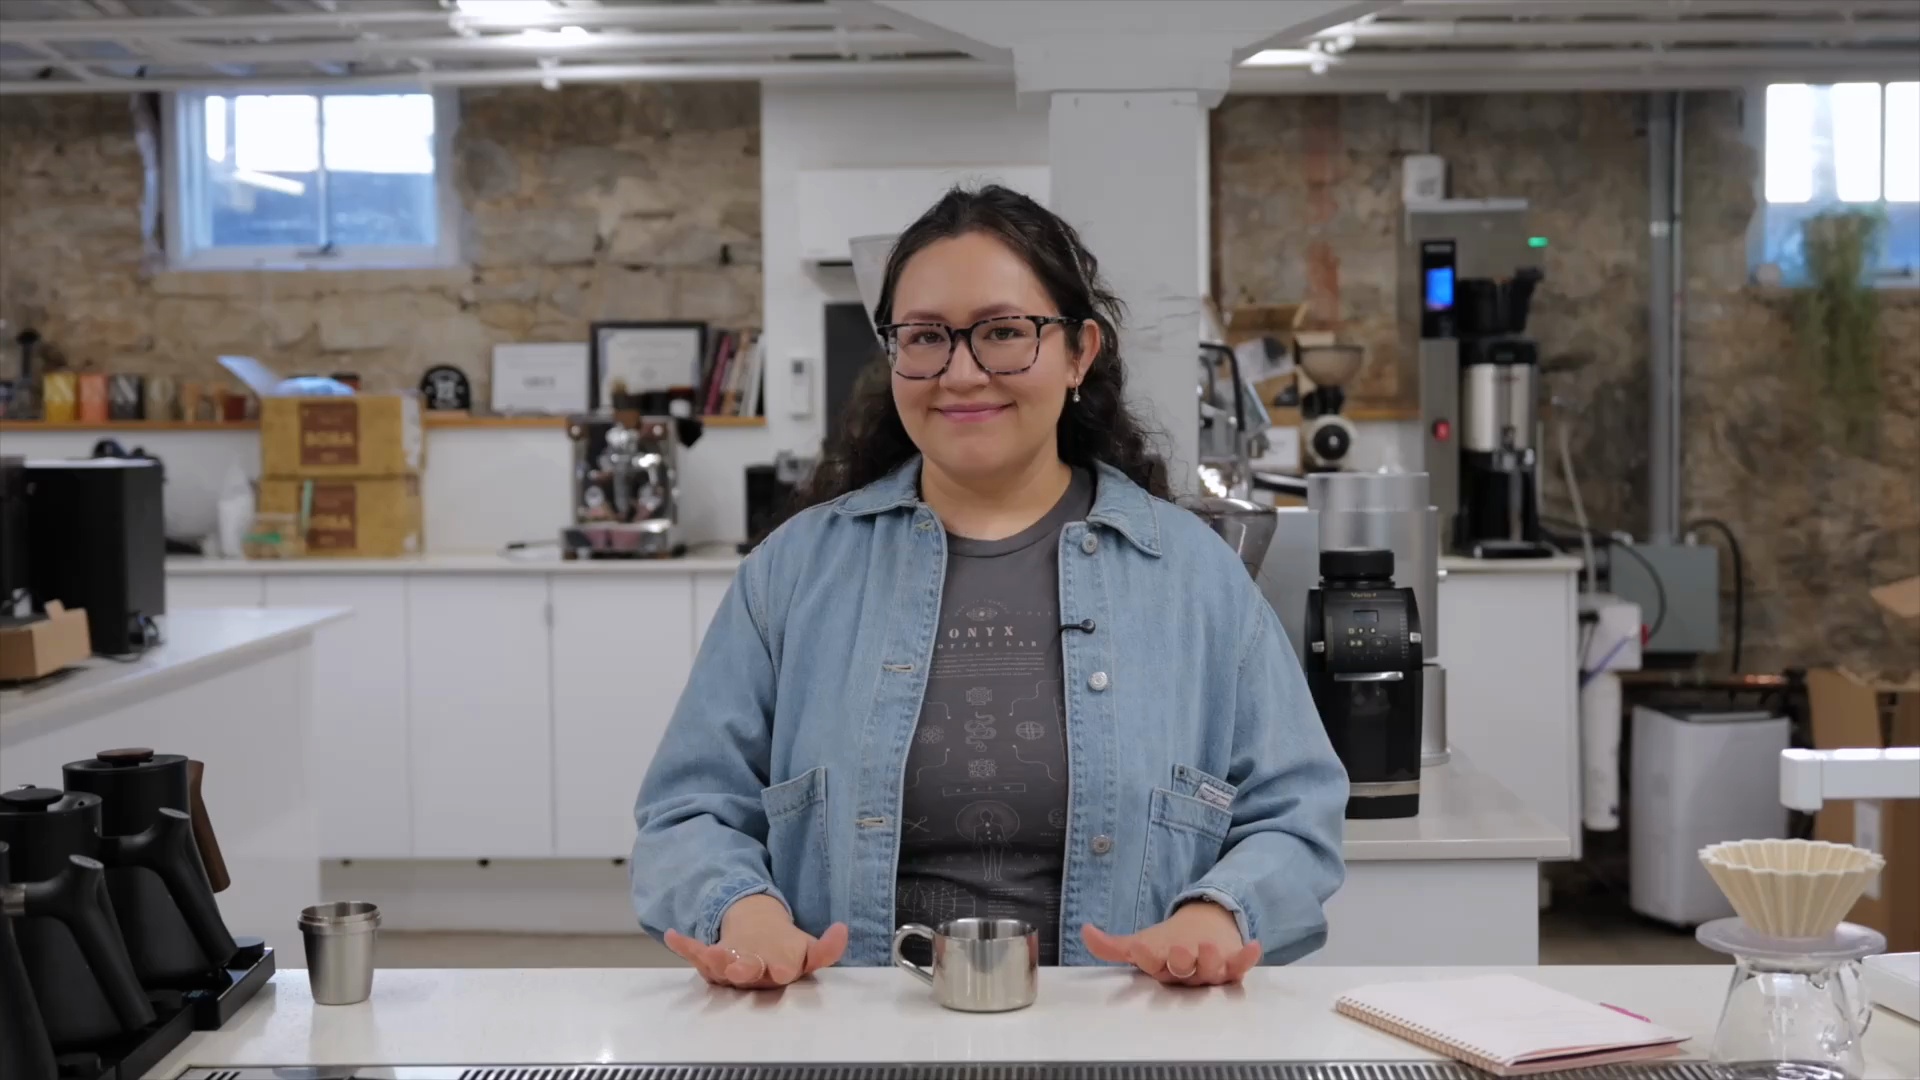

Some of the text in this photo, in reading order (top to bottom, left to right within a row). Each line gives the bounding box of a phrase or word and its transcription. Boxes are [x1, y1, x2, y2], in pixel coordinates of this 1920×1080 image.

[949, 625, 1014, 639] ONYX
[937, 640, 1037, 650] OFFEE LAB
